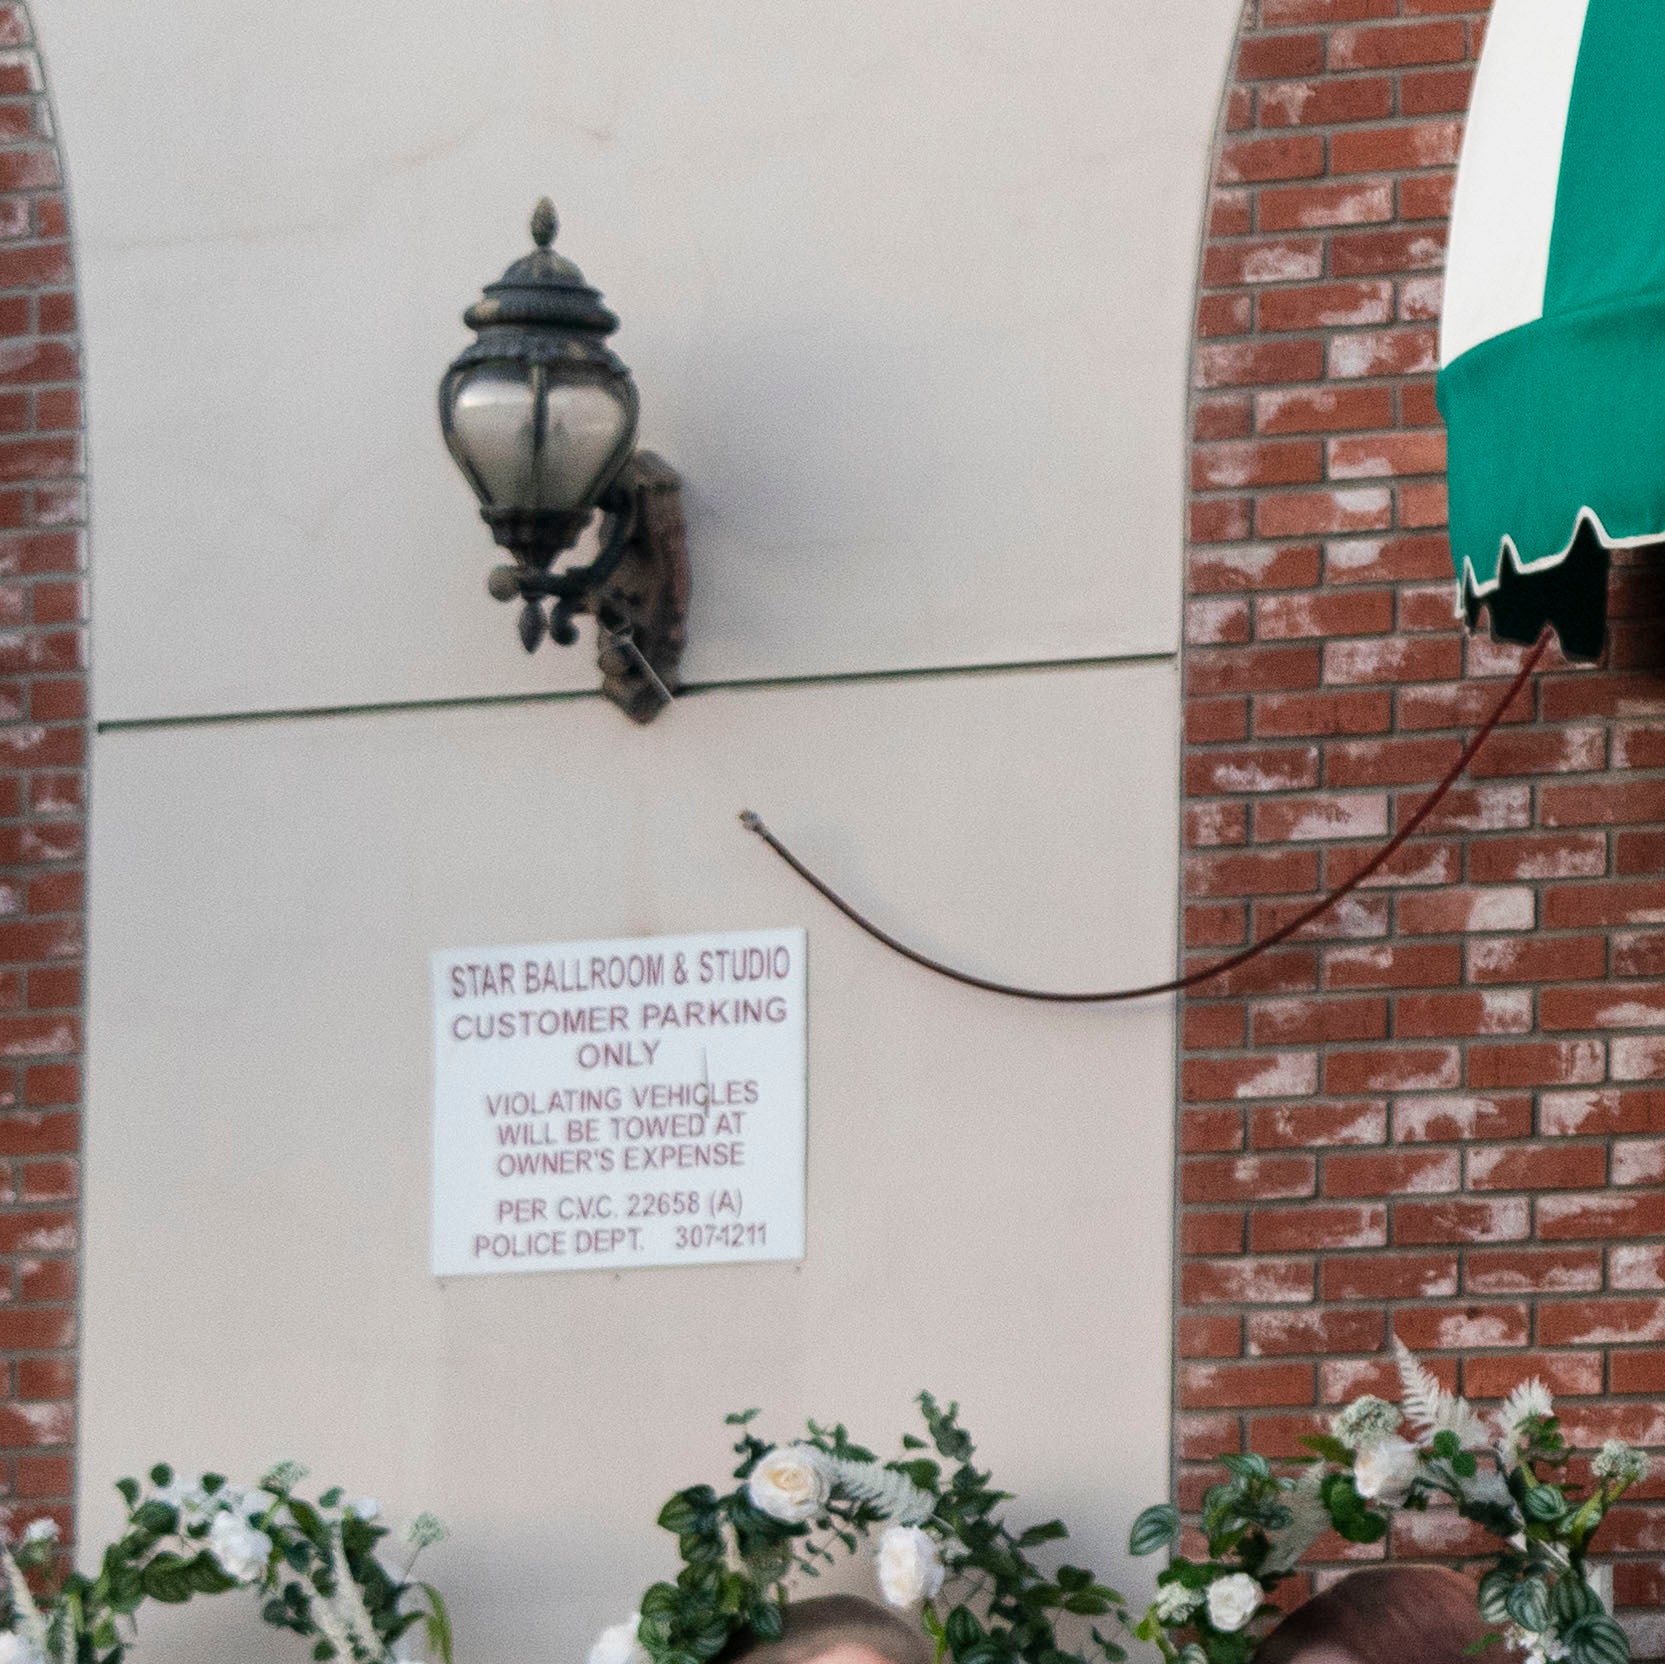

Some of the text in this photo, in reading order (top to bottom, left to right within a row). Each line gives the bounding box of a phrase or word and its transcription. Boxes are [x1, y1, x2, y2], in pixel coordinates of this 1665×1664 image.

[451, 945, 791, 999] STAR BALLROOM & STUDIO
[451, 996, 788, 1041] CUSTOMER PARKING
[577, 1040, 661, 1069] ONLY
[486, 1080, 760, 1118] VIOLATING VEHICLES
[497, 1111, 747, 1147] WILL BE TOWED AT
[497, 1142, 745, 1178] OWNER'S EXPENSE
[498, 1198, 547, 1224] PER
[626, 1191, 700, 1218] 22658
[709, 1189, 743, 1217] (A)
[473, 1230, 566, 1259] POLICE
[575, 1227, 644, 1254] DEPT.
